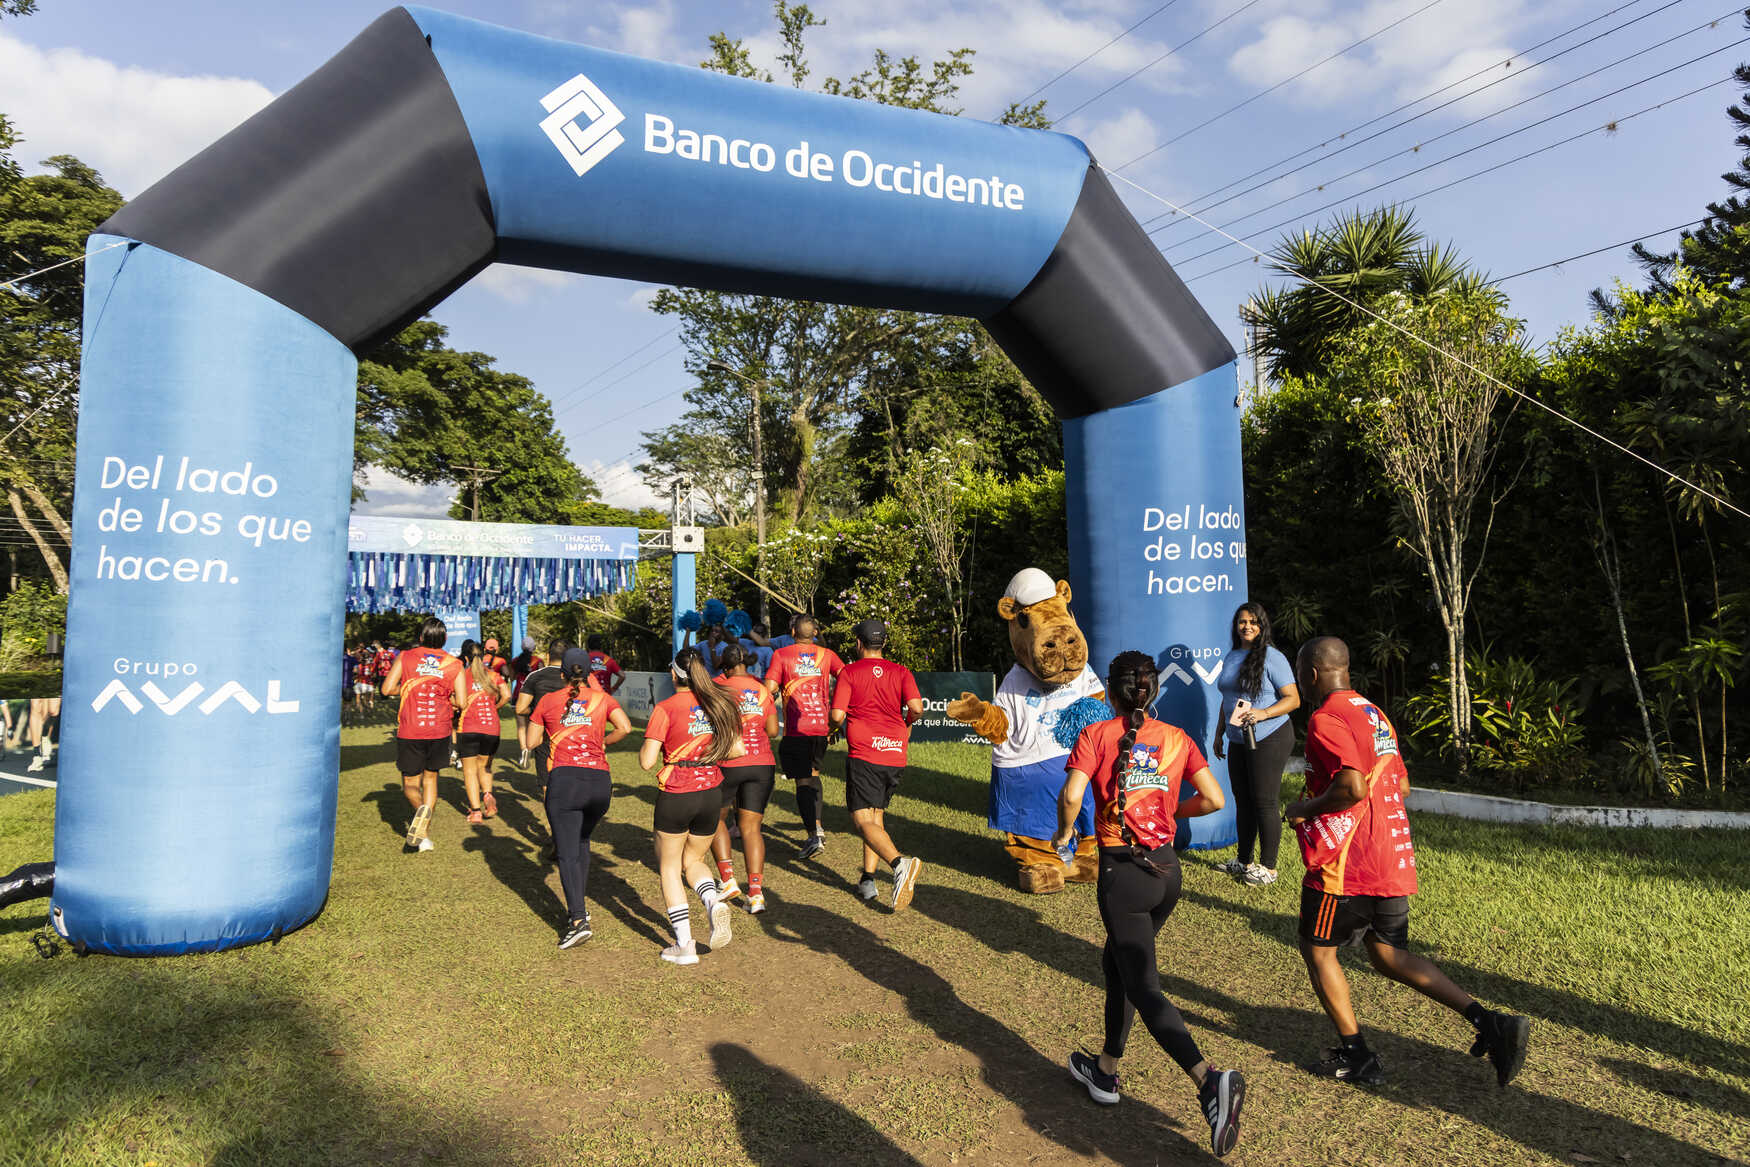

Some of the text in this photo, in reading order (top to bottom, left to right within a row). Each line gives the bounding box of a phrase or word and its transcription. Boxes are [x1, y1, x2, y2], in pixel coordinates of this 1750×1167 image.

[644, 113, 1024, 210] Banco de Occidente
[101, 455, 278, 498] Del lado
[98, 497, 143, 532] de
[157, 498, 222, 536] los
[238, 514, 312, 547] que
[1143, 504, 1240, 531] Del lado
[554, 534, 604, 544] TU HACER.
[565, 544, 613, 552] IMPACTA.
[1144, 534, 1246, 565] de los qu
[97, 545, 239, 585] hacen.
[1147, 570, 1233, 595] hacen.
[1170, 647, 1221, 659] Grupo
[113, 657, 198, 678] Grupo
[91, 679, 300, 716] AVAL
[924, 719, 940, 728] que
